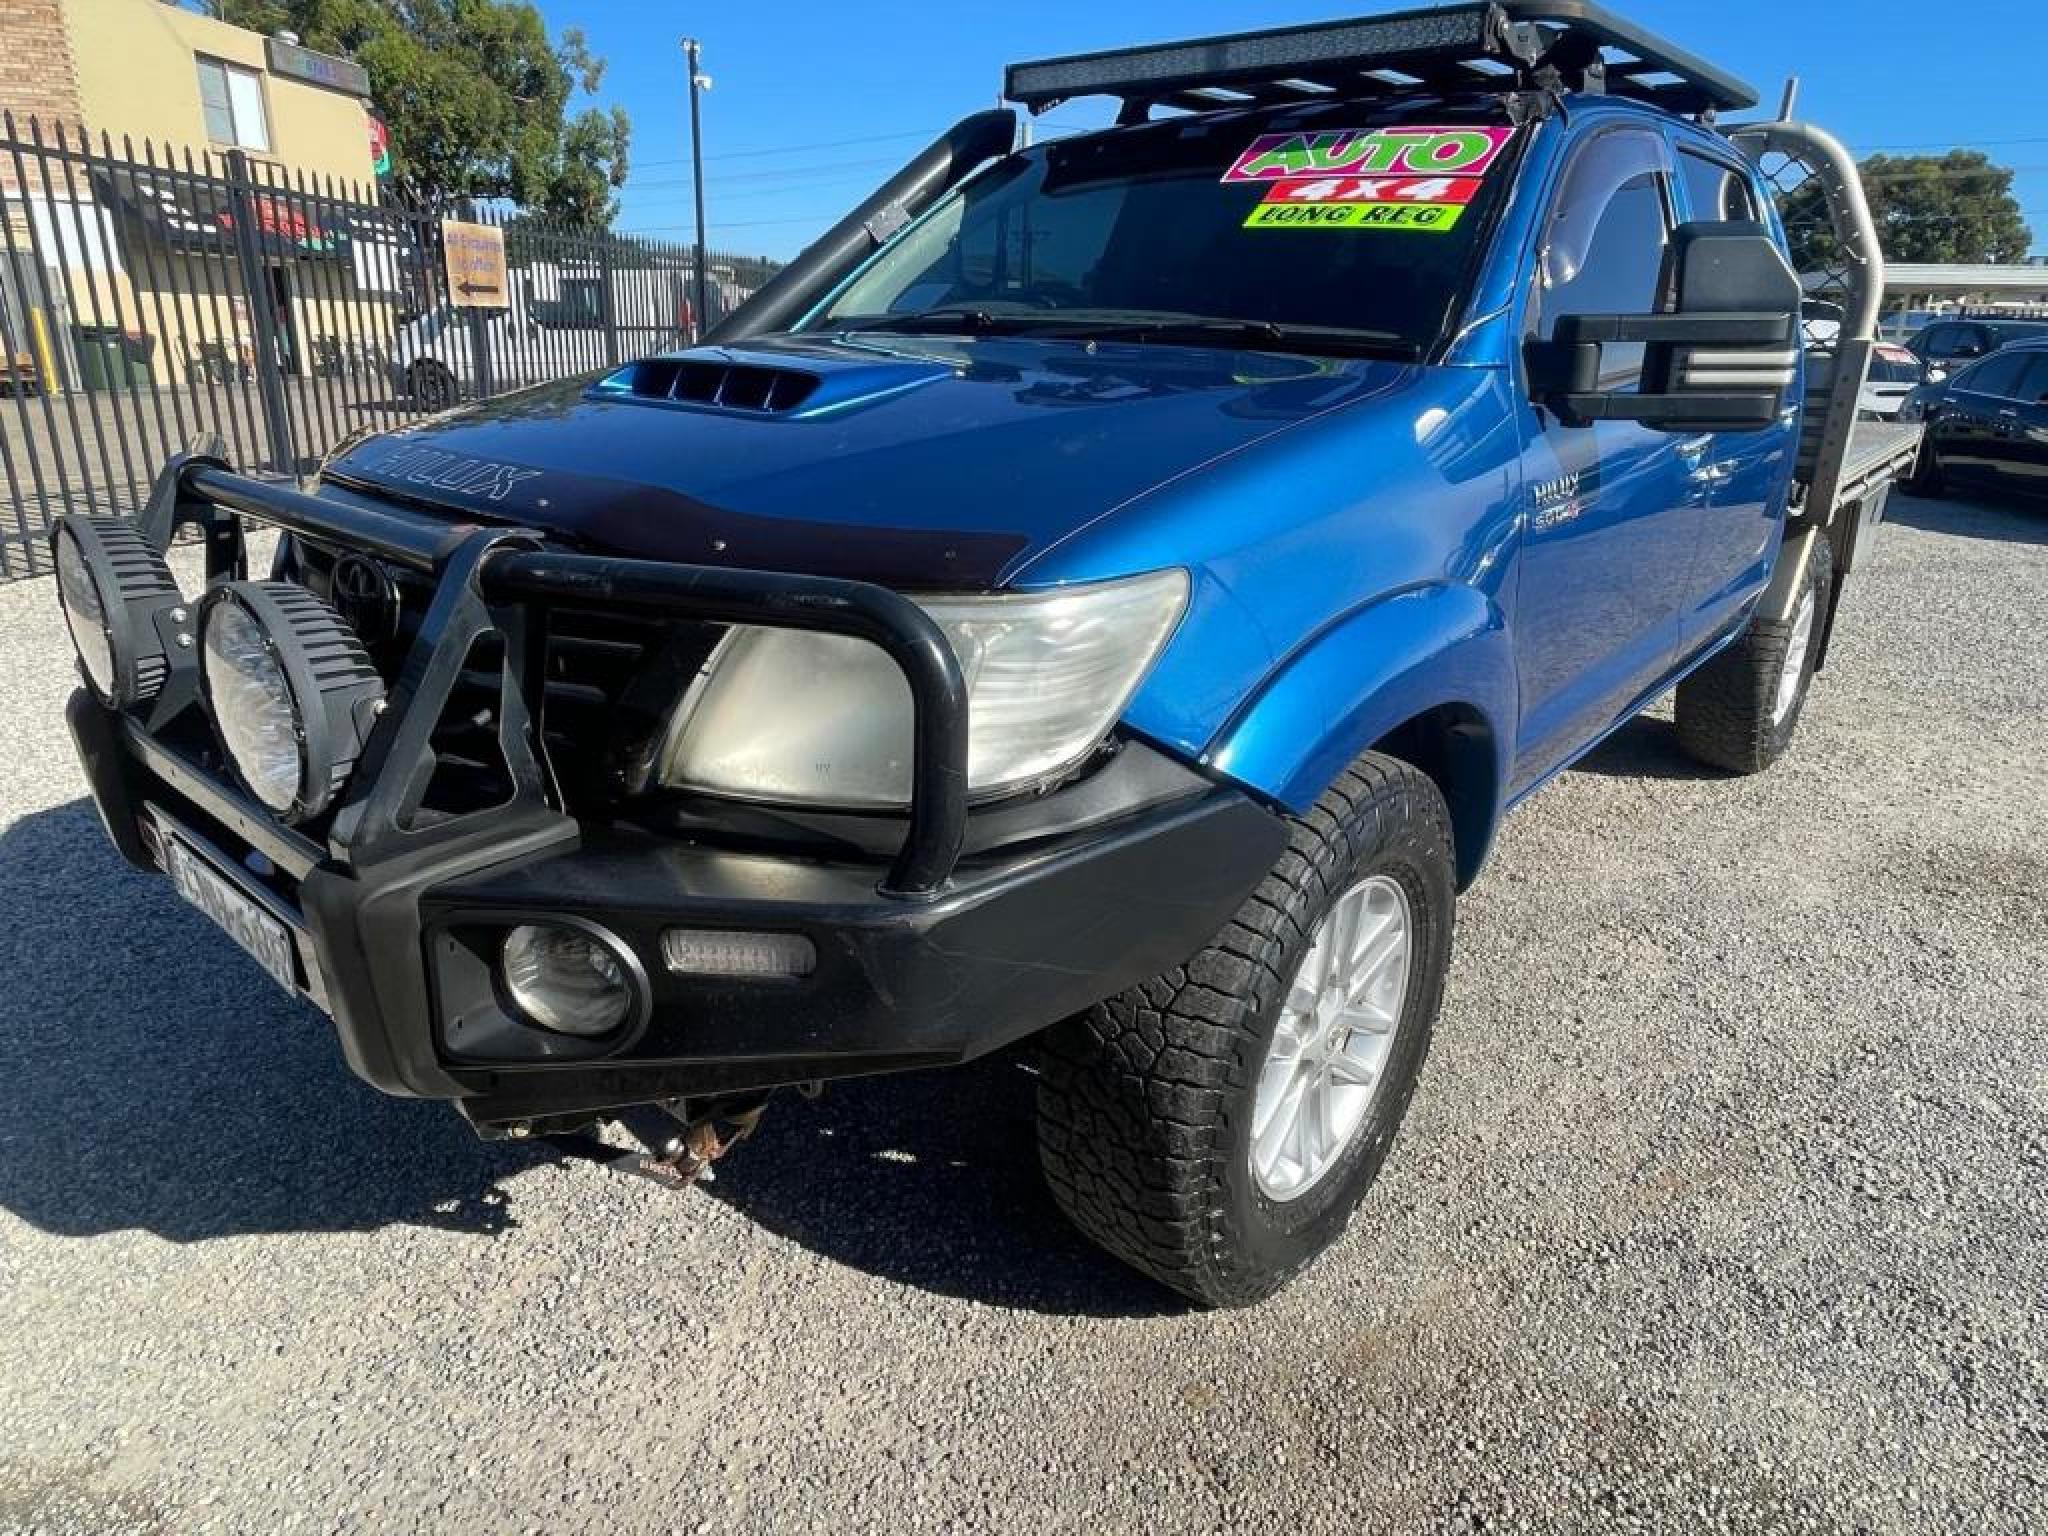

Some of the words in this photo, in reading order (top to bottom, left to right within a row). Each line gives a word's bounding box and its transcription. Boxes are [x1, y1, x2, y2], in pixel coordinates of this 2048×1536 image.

[1238, 130, 1493, 176] AUTO
[1258, 204, 1353, 224] LONG
[1360, 205, 1445, 226] REG
